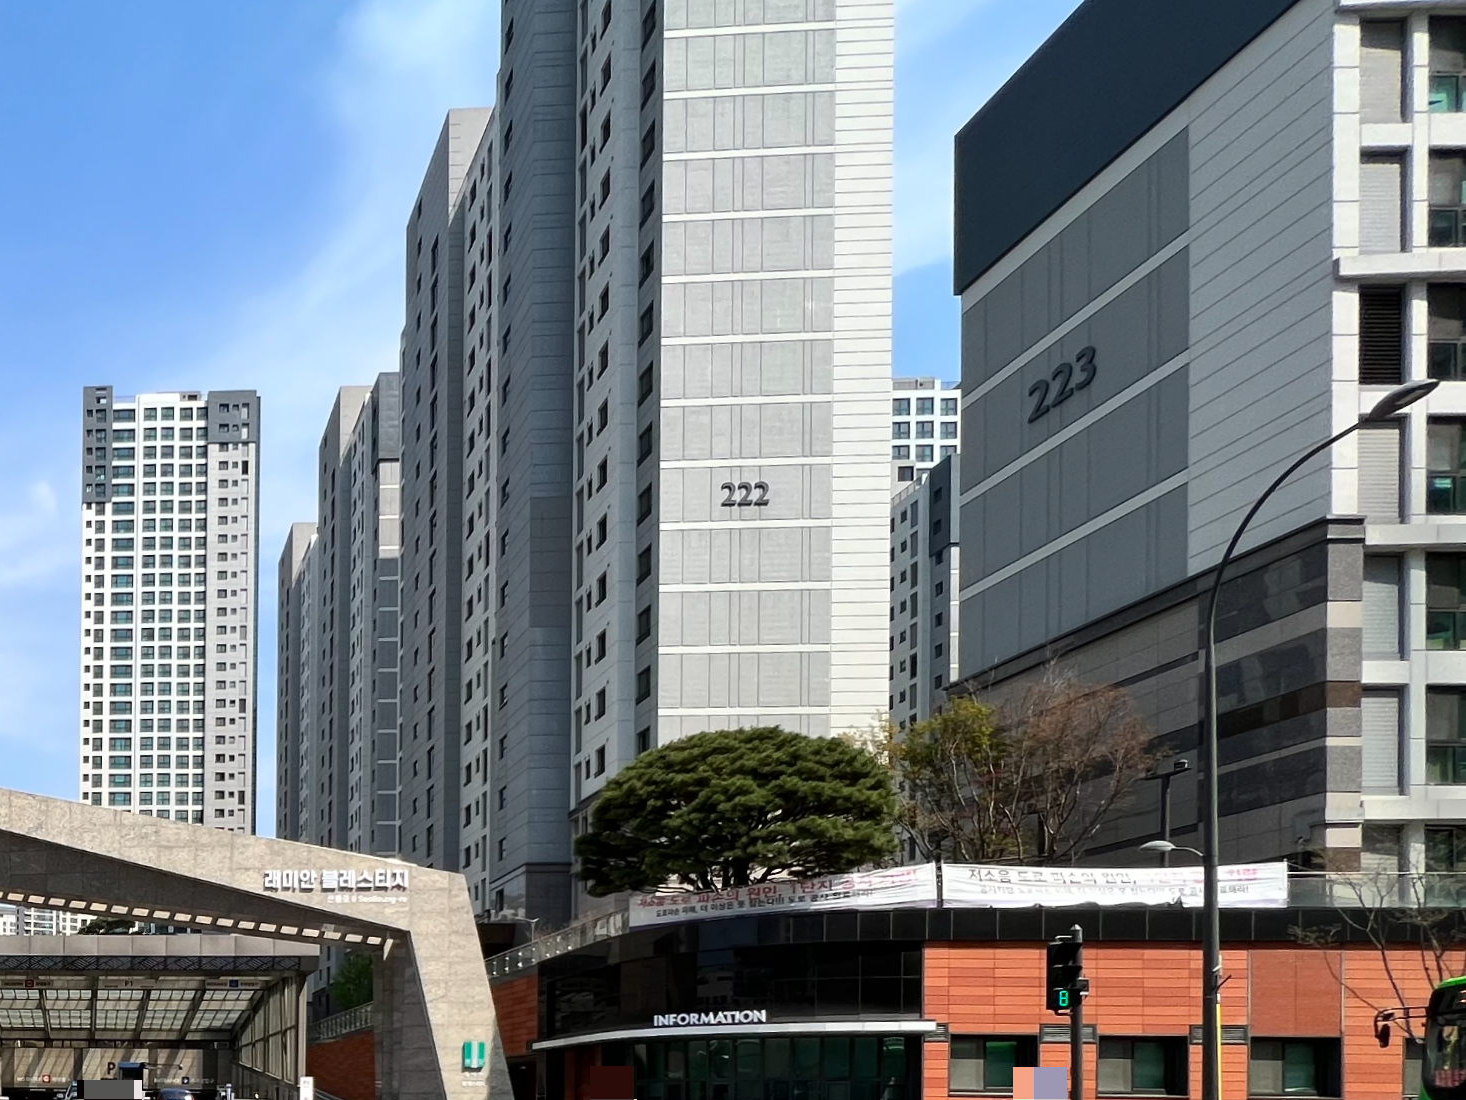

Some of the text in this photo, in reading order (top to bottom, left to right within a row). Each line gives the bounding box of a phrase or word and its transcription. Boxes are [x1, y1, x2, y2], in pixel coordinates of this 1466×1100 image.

[1028, 346, 1097, 424] 223
[721, 481, 770, 507] 222
[264, 868, 409, 891] 래미안 블레스티지
[969, 868, 1011, 883] 저소음
[1017, 871, 1047, 882] 도로
[1050, 872, 1097, 884] 파손의
[1059, 990, 1069, 1007] 8
[653, 1009, 767, 1027] INFORMATION
[107, 1062, 116, 1075] P
